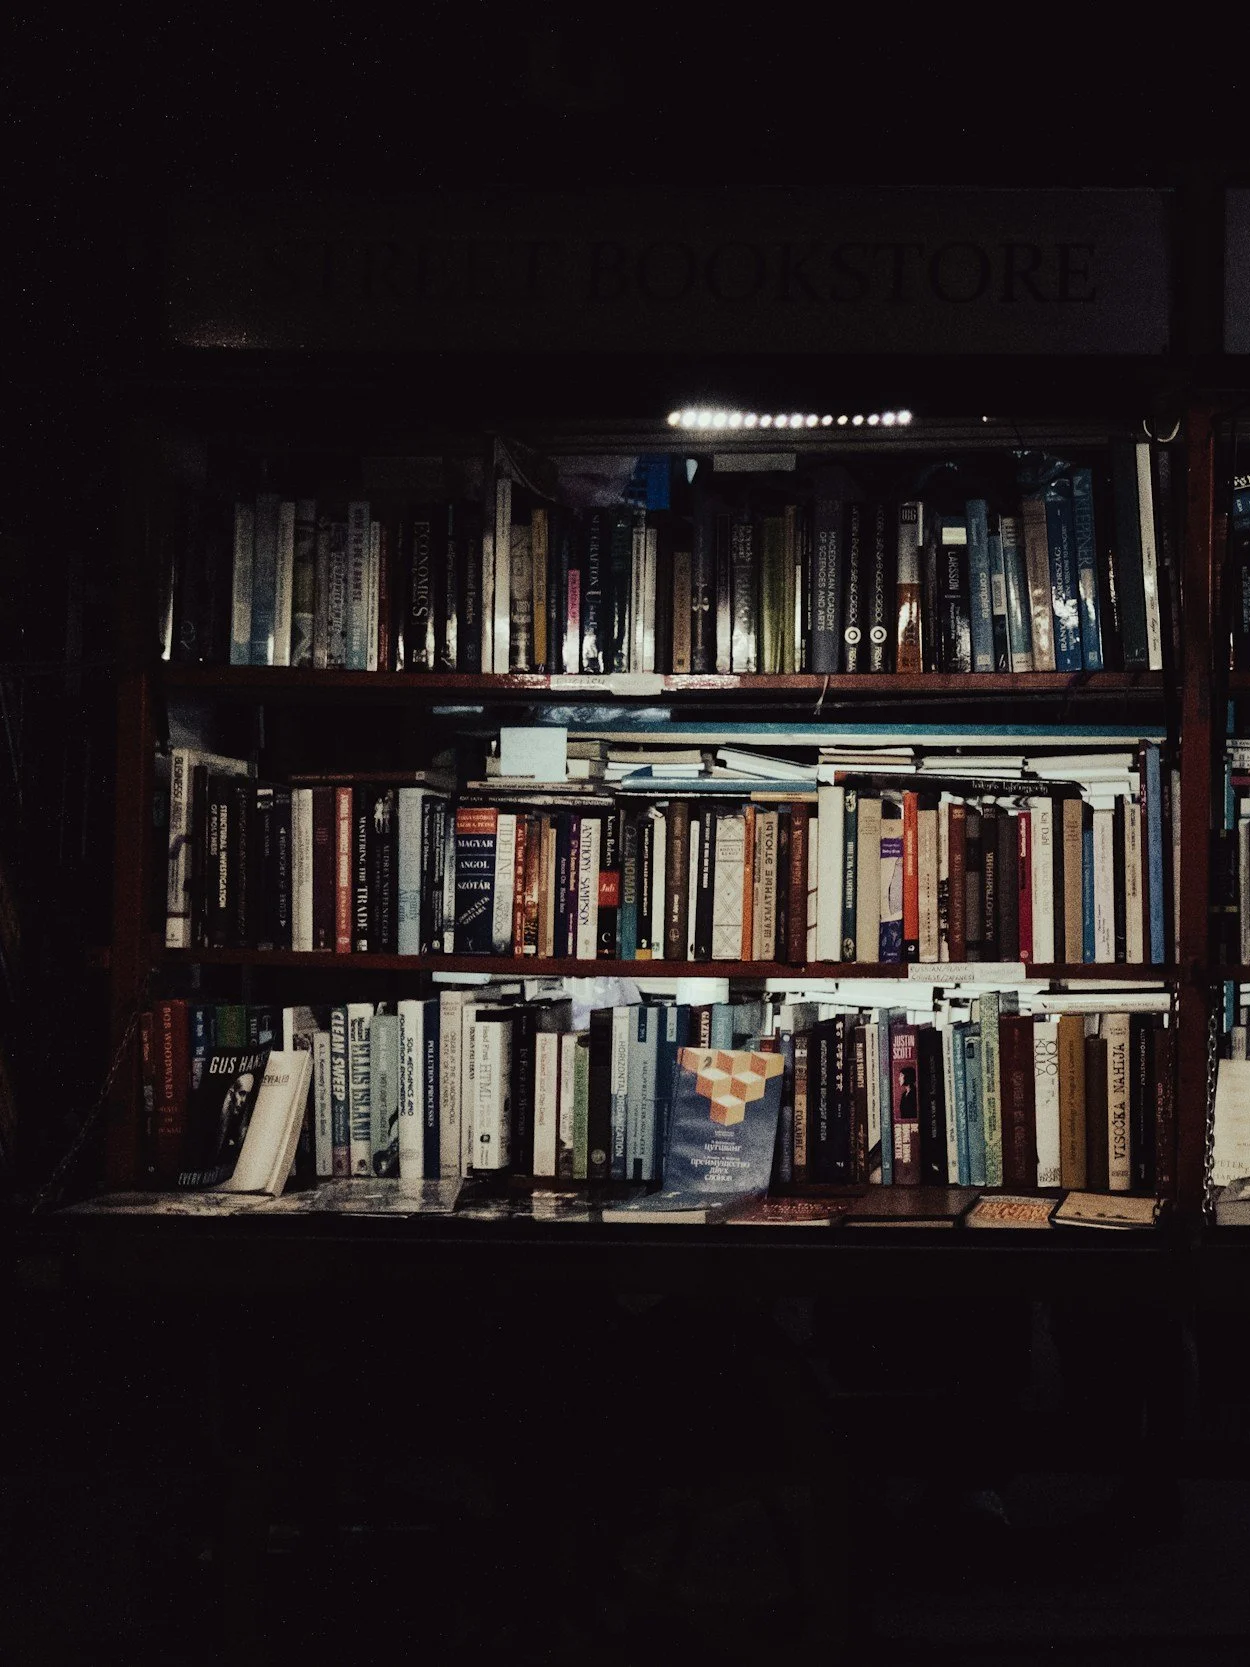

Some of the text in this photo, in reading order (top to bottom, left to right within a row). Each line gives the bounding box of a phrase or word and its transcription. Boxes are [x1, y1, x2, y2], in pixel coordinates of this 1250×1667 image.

[587, 240, 1096, 302] BOOKSTORE
[412, 520, 432, 617] ECONOMICS
[589, 536, 600, 586] GRAFTON
[818, 532, 826, 631] OF SCIENCES AND ARTS
[827, 532, 836, 631] MACEDONIAN ACADEMY
[947, 551, 960, 590] LARSSON
[980, 572, 989, 618] complete
[219, 804, 227, 908] STRUCTURAL INVESTIGATION
[457, 840, 493, 848] MAGYAR
[500, 823, 513, 879] TIDELINE
[606, 839, 614, 867] Roberts
[1041, 827, 1049, 845] Dahl
[457, 879, 491, 891] SZÓTÁR
[460, 861, 489, 869] ANGOL
[579, 825, 591, 925] ANTHONY SAMPSON
[625, 857, 636, 904] NOMAD
[764, 821, 773, 938] ШАХМАТНЫЕ ЭТЮДЫ
[357, 886, 368, 931] TRADE
[162, 1007, 173, 1099] BOB WOODWARD
[210, 1056, 235, 1074] GUS
[331, 1011, 346, 1101] CLEAN SWEEP
[893, 1034, 915, 1046] JUSTIN
[893, 1046, 913, 1059] SCOTT
[352, 1043, 370, 1141] ELLIS ISLAND
[427, 1040, 435, 1127] POLLUTION PROCESSES
[479, 1063, 491, 1102] HTML
[1112, 1043, 1126, 1093] NAHIJA
[615, 1094, 624, 1157] ORGANIZATION
[691, 1158, 750, 1167] преимущество
